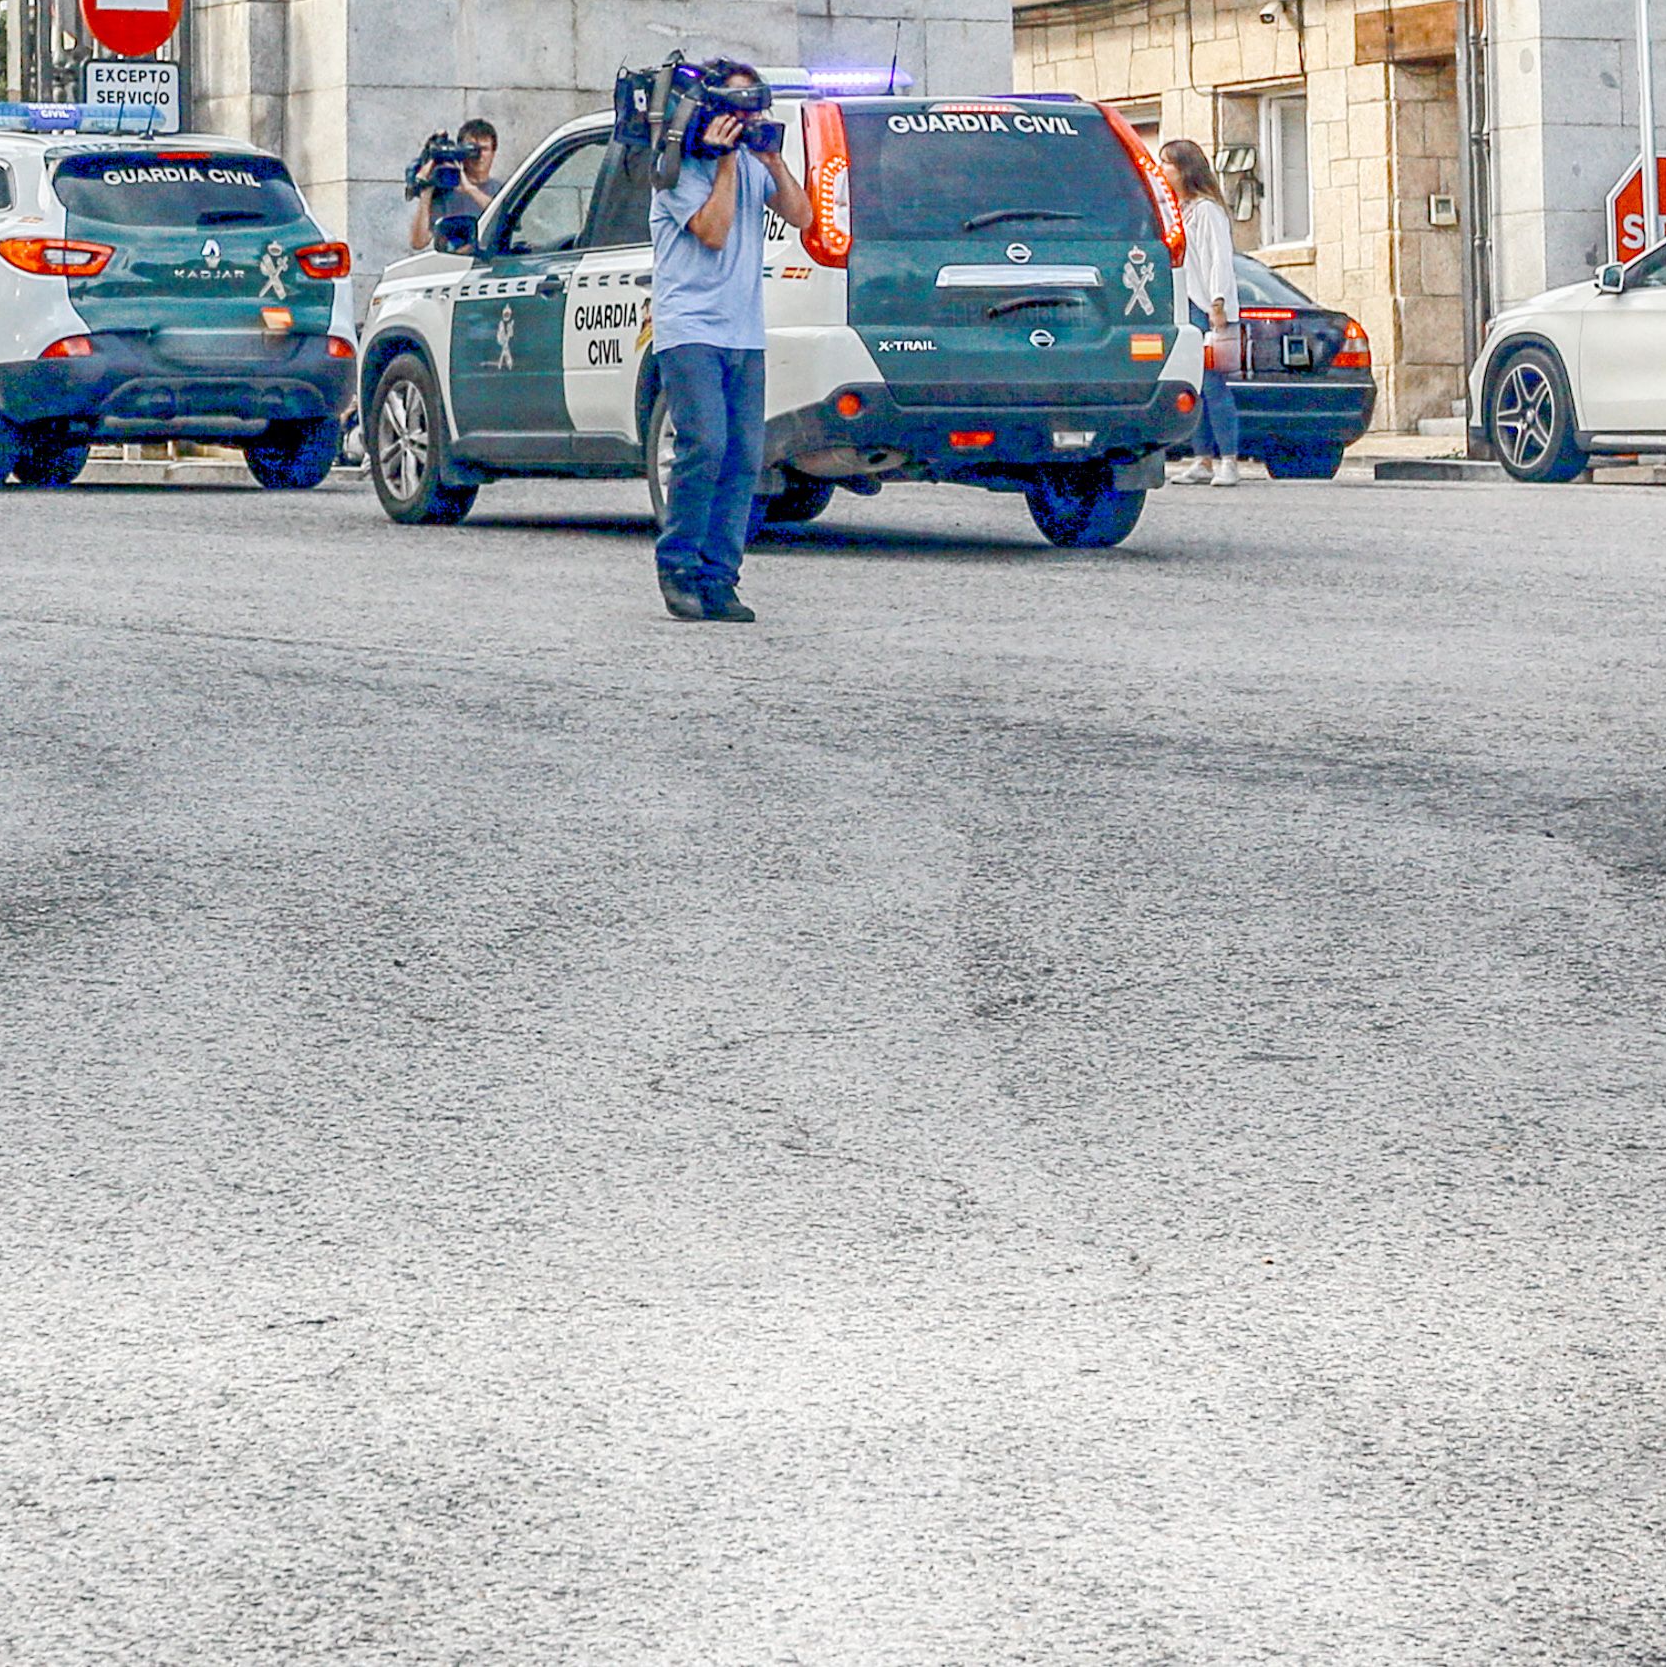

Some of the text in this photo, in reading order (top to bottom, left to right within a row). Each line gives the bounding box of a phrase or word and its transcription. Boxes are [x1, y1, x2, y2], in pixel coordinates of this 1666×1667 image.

[95, 68, 171, 84] EXCEPTO
[96, 90, 170, 105] SERVICIO
[39, 109, 71, 119] CIVIL
[887, 113, 1079, 136] GUARDIA CIVIL
[102, 165, 262, 188] GUARDIA CIVIL
[173, 268, 246, 280] KADJAR
[574, 302, 637, 331] GUARDIA
[587, 338, 623, 366] CIVIL
